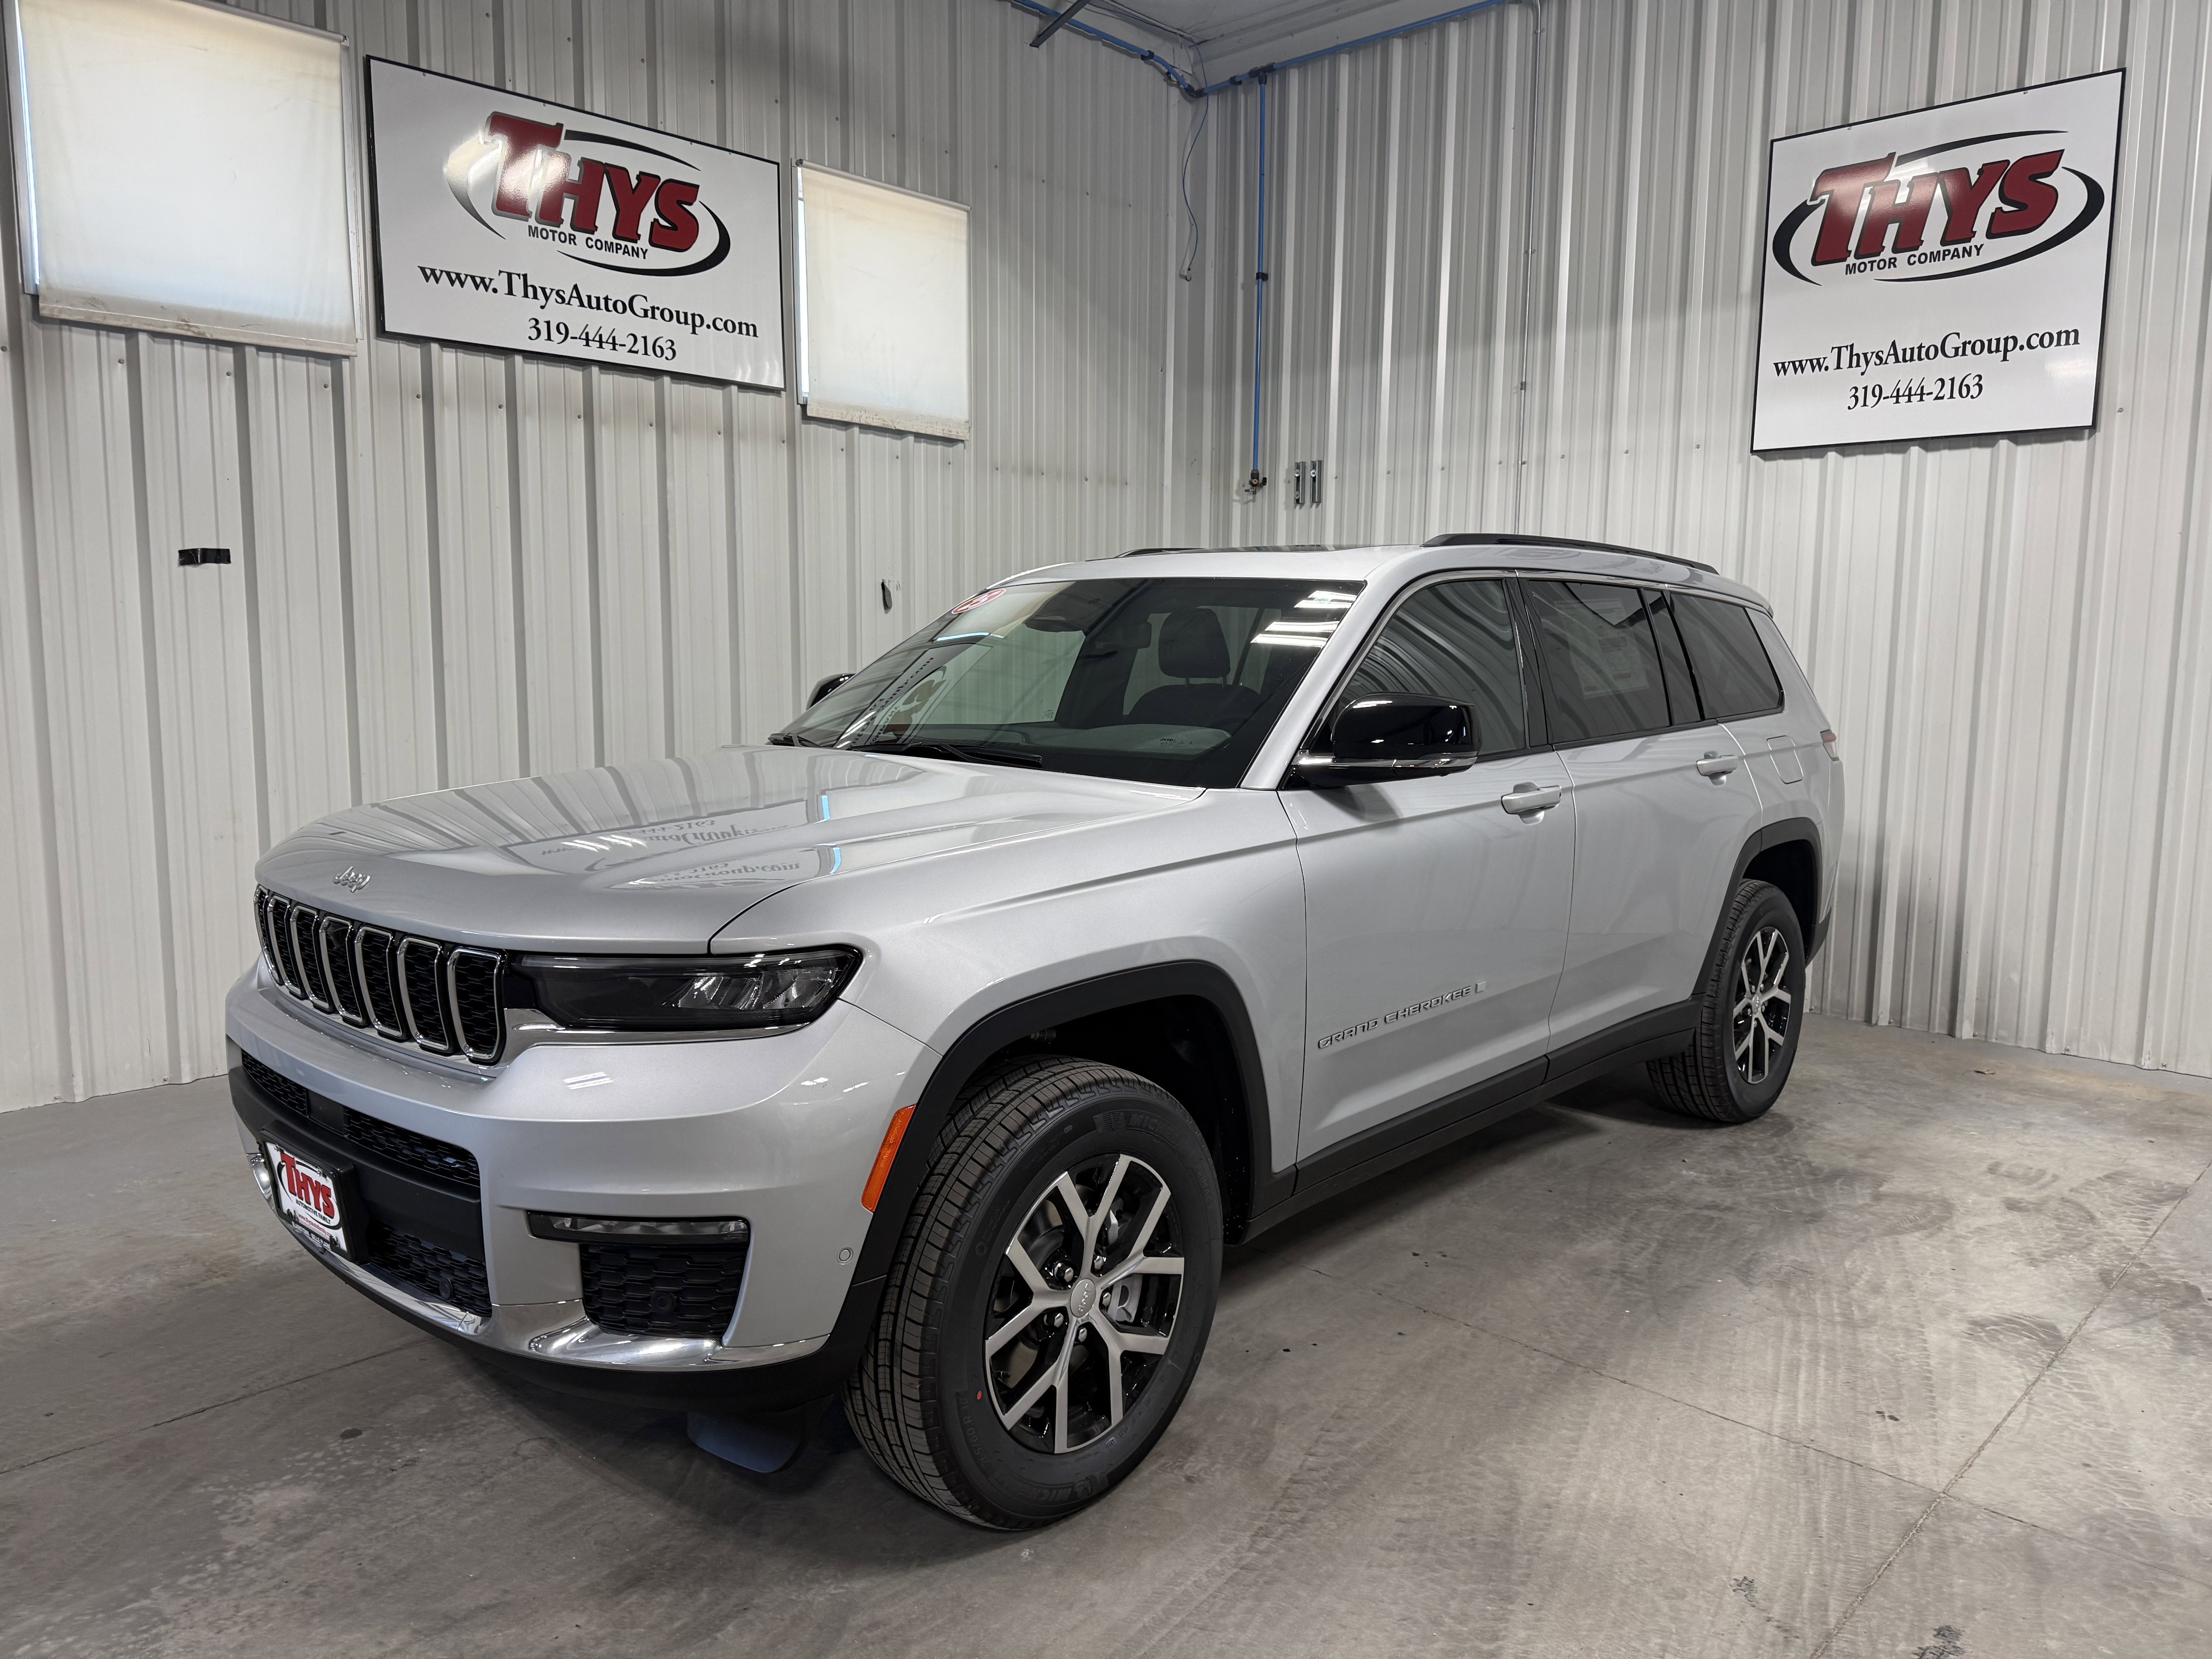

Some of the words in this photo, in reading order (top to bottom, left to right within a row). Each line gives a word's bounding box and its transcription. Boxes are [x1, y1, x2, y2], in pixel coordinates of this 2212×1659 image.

[484, 111, 700, 253] THYS
[1807, 149, 2065, 266] THYS
[528, 225, 577, 247] MOTOR
[585, 237, 649, 260] COMPANY
[1845, 257, 1898, 275] MOTOR
[1907, 244, 1984, 266] COMPANY
[417, 265, 759, 338] www.ThysAutoGroup.com
[528, 317, 677, 361] 319-444-2163
[1773, 328, 2080, 377] www.ThysAutoGroup.com
[1847, 373, 1983, 410] 319-444-2163
[1318, 1018, 1379, 1049] GRAND
[1384, 986, 1472, 1024] CHEROKEE
[280, 1152, 335, 1219] THYS
[1078, 1283, 1091, 1313] Jeep
[960, 1398, 971, 1410] 18
[963, 1415, 972, 1425] R
[967, 1427, 991, 1467] 265/60
